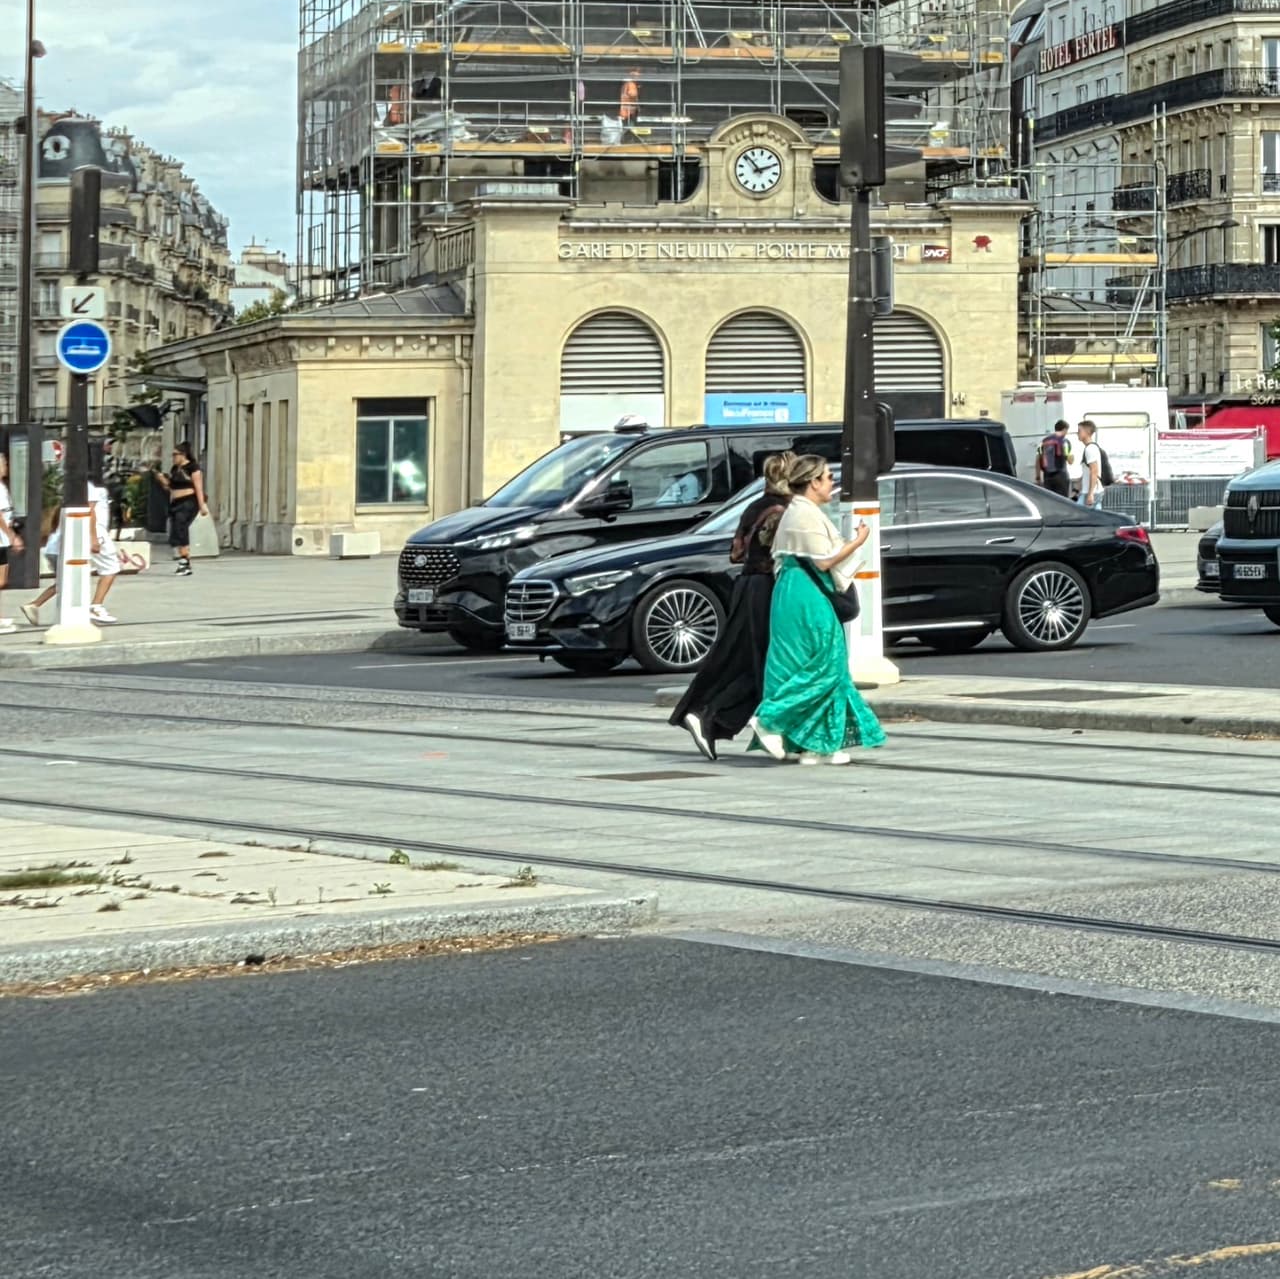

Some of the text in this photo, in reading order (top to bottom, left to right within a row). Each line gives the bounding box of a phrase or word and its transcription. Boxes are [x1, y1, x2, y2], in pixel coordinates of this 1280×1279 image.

[1040, 25, 1115, 73] HOTEL FERTEL
[558, 242, 612, 259] GARE
[621, 242, 649, 259] DE
[657, 242, 736, 259] NEUILLY
[756, 242, 817, 259] PORTE
[924, 248, 949, 258] SNCF
